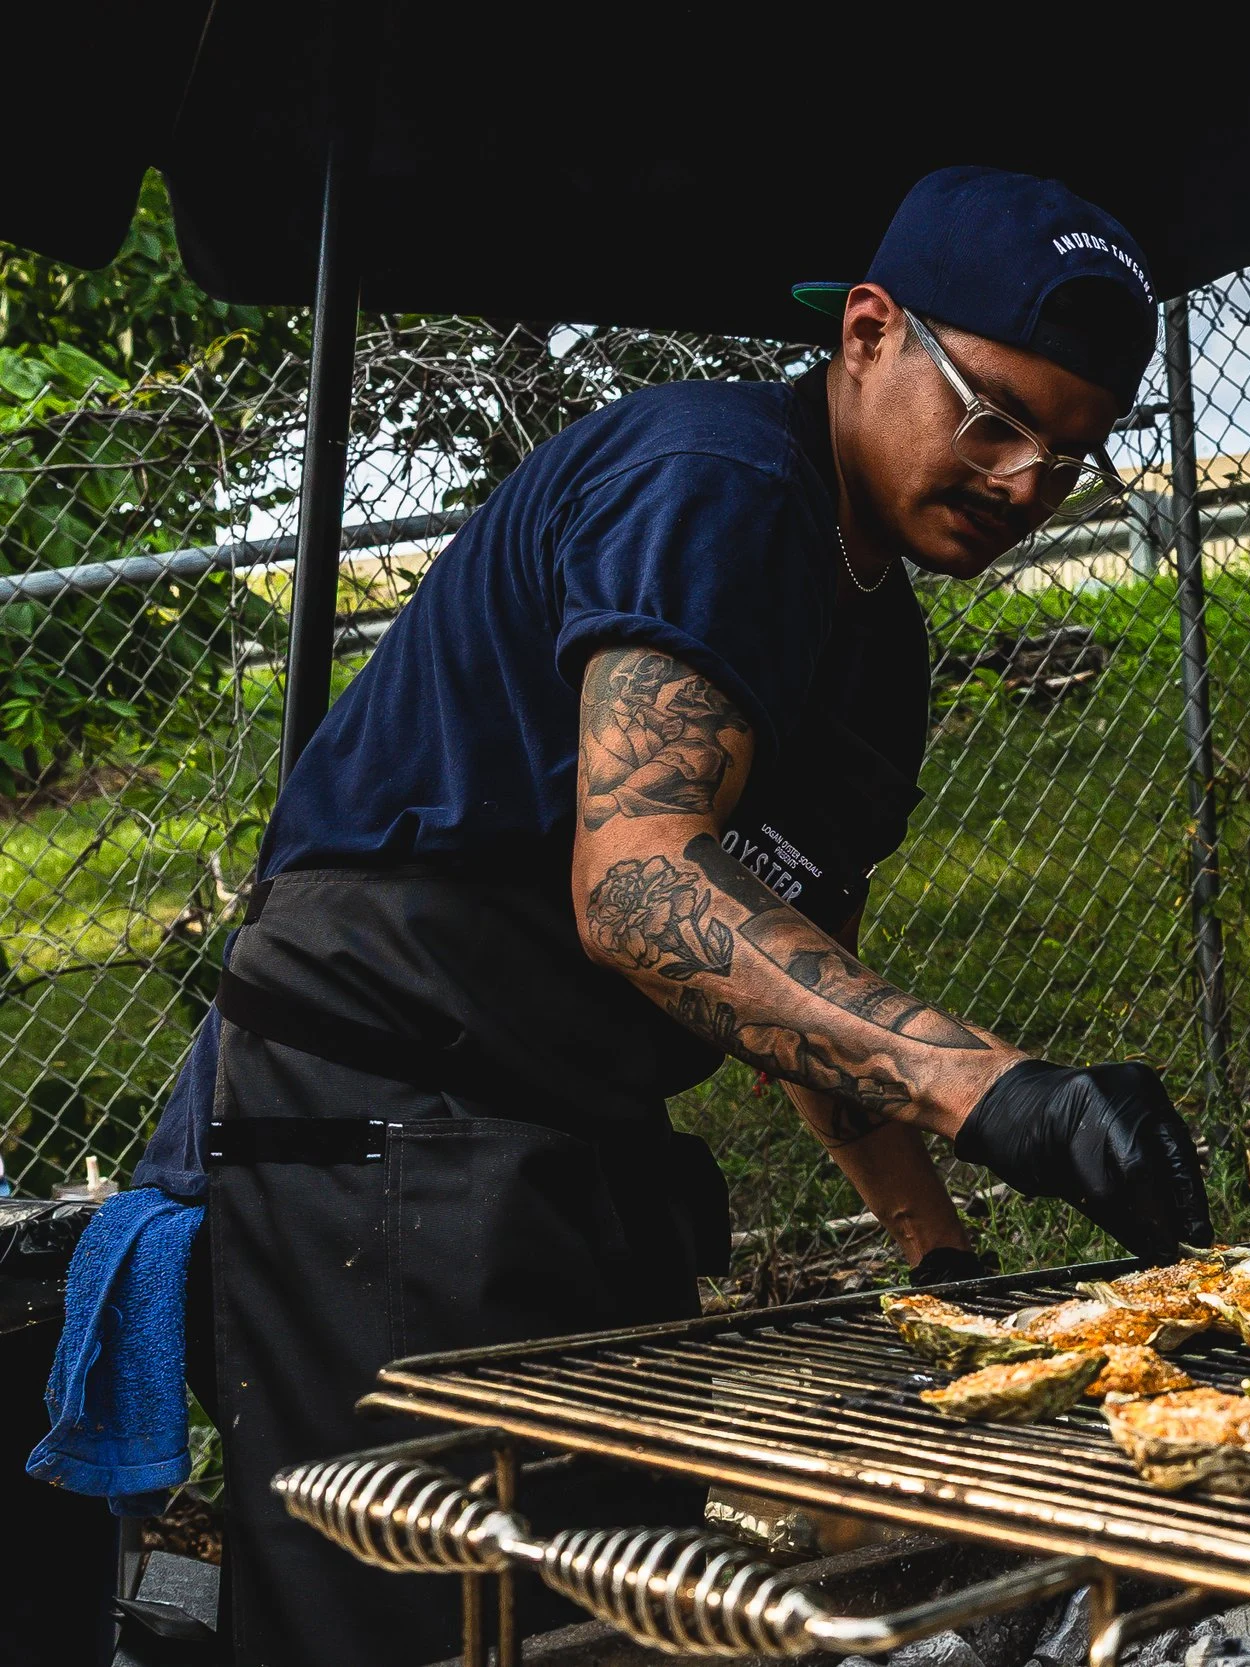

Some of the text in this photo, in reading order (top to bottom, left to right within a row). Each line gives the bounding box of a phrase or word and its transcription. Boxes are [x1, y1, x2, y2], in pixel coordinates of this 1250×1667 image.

[1052, 232, 1109, 255] ANDROS
[721, 830, 802, 904] OYSTER
[761, 823, 823, 878] LOGAN OYSTER SOCIALS
[774, 846, 799, 869] PRESENTS
